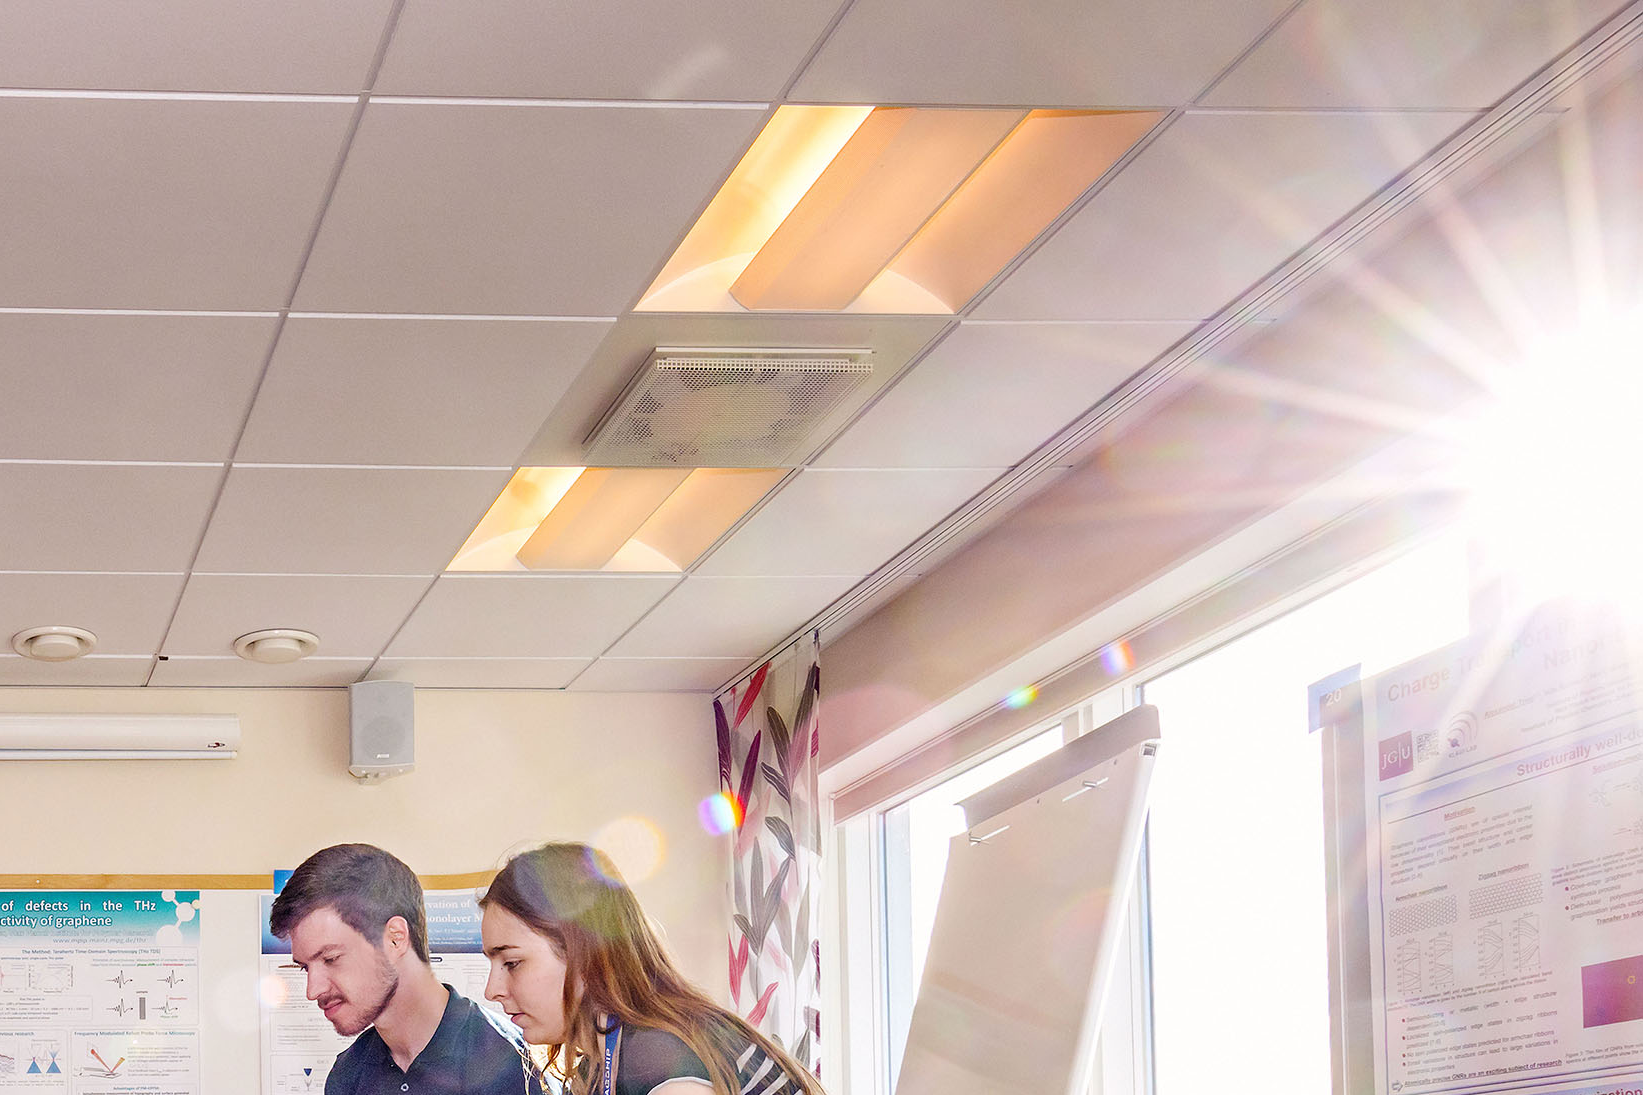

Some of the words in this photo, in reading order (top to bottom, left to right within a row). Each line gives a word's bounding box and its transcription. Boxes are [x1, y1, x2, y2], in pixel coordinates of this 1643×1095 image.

[1325, 690, 1341, 705] 20
[1517, 744, 1591, 776] Structurally
[1, 900, 14, 911] of
[25, 900, 68, 911] defects
[80, 901, 91, 911] in
[103, 900, 122, 911] the
[135, 900, 156, 911] THz
[429, 900, 457, 908] vation
[461, 899, 470, 908] of
[41, 915, 54, 926] of
[56, 917, 112, 929] graphene
[429, 913, 471, 925] onolayer
